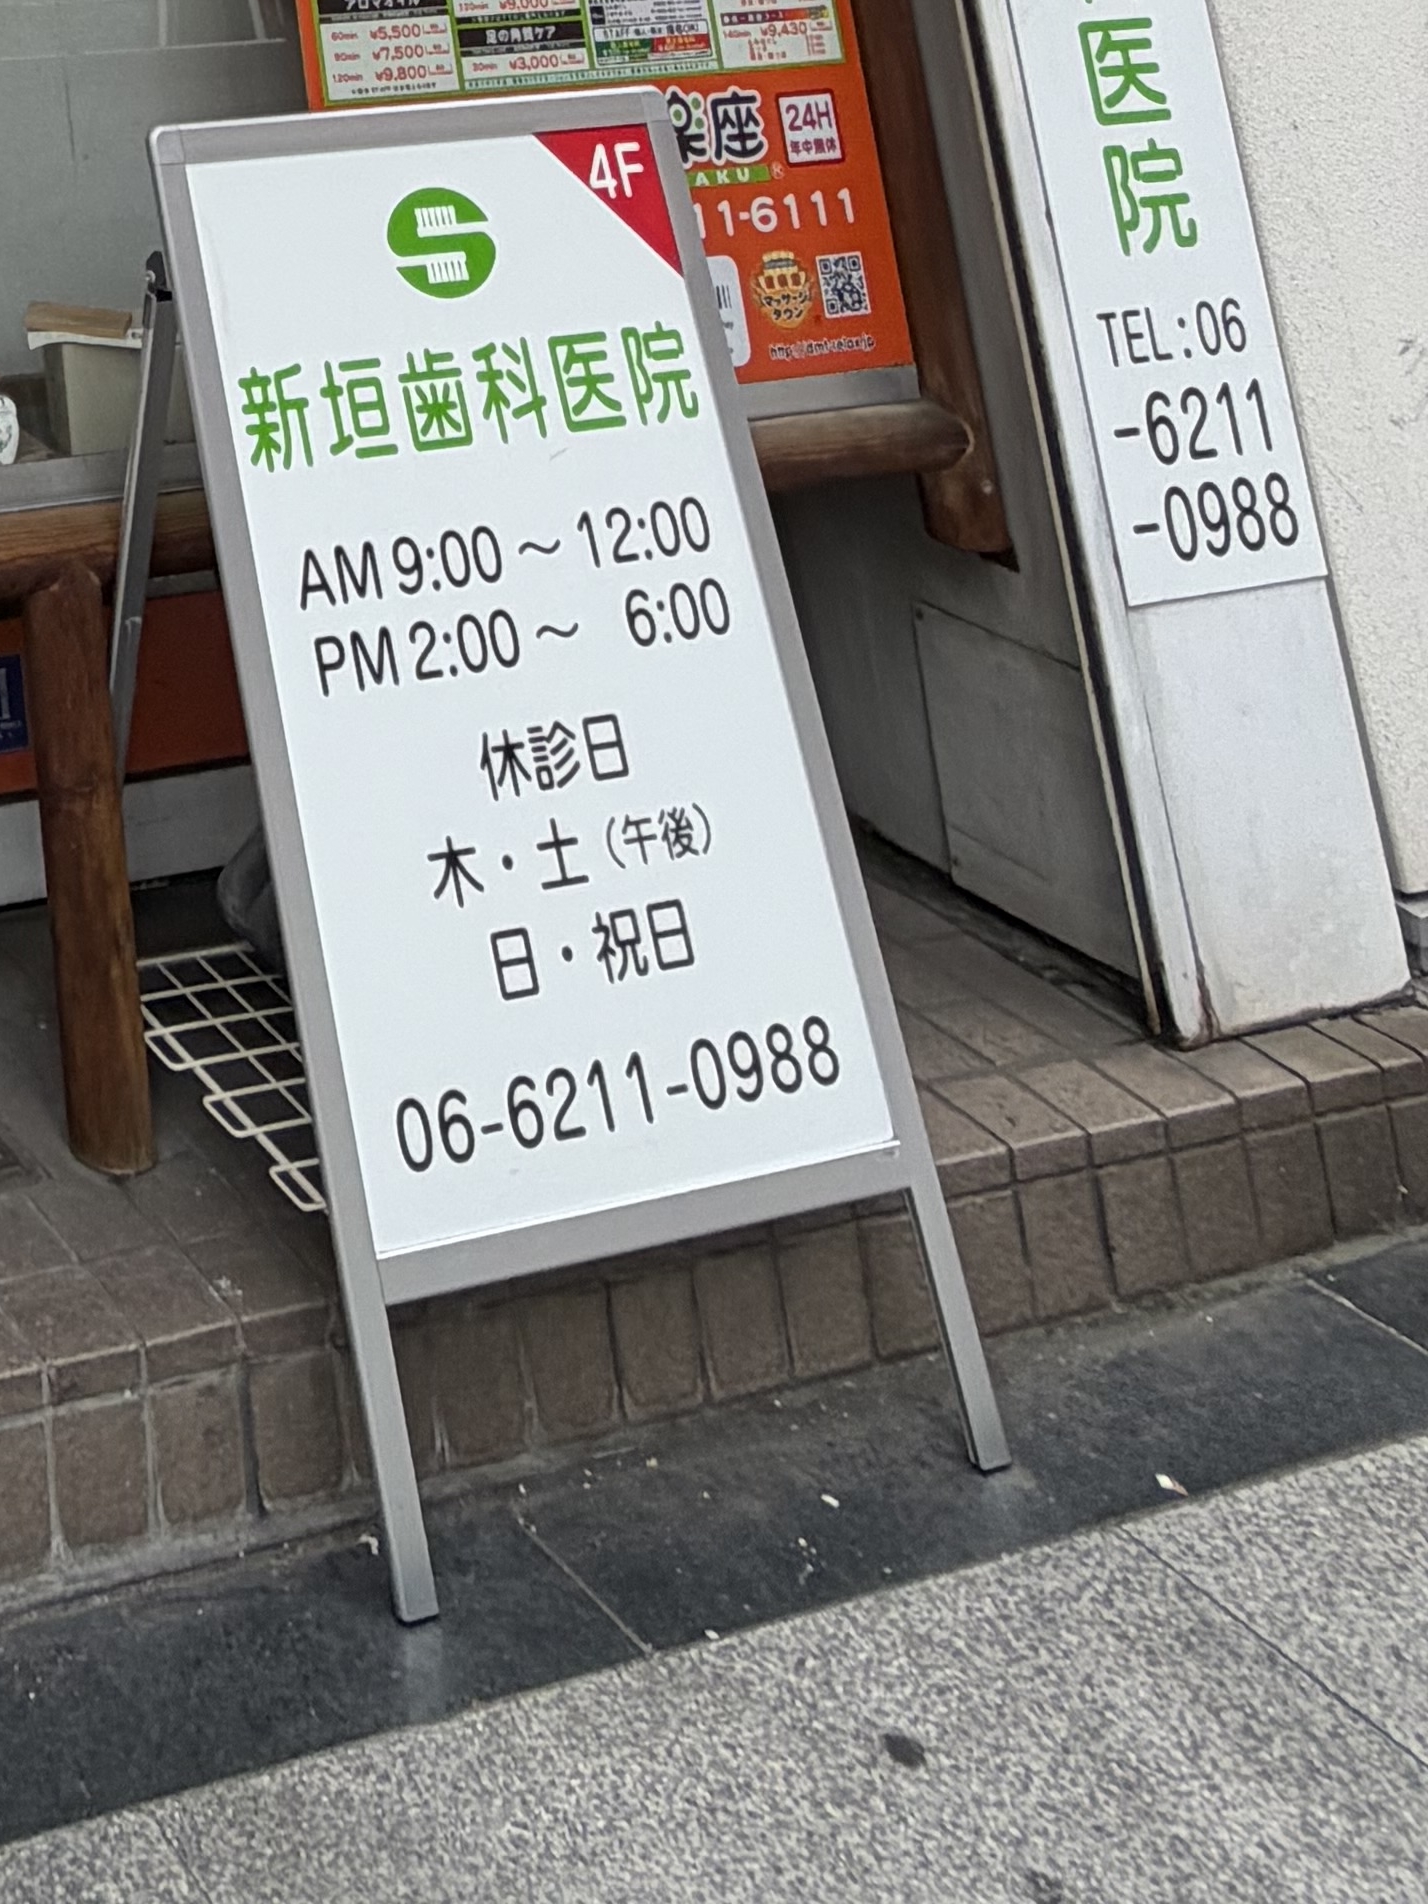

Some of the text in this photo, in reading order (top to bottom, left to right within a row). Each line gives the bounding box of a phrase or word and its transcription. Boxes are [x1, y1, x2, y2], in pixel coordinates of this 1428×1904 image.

[785, 99, 834, 133] 24H
[588, 141, 645, 200] 4F
[772, 307, 805, 321] タウン
[1095, 294, 1248, 371] TEL:06
[238, 319, 700, 473] 新垣歯科医院
[1112, 377, 1277, 465] -6211
[1132, 470, 1300, 565] -0988
[480, 712, 629, 801] 休診日
[490, 898, 696, 1001] 日・祝日
[395, 1014, 841, 1173] 06-6211-0988
